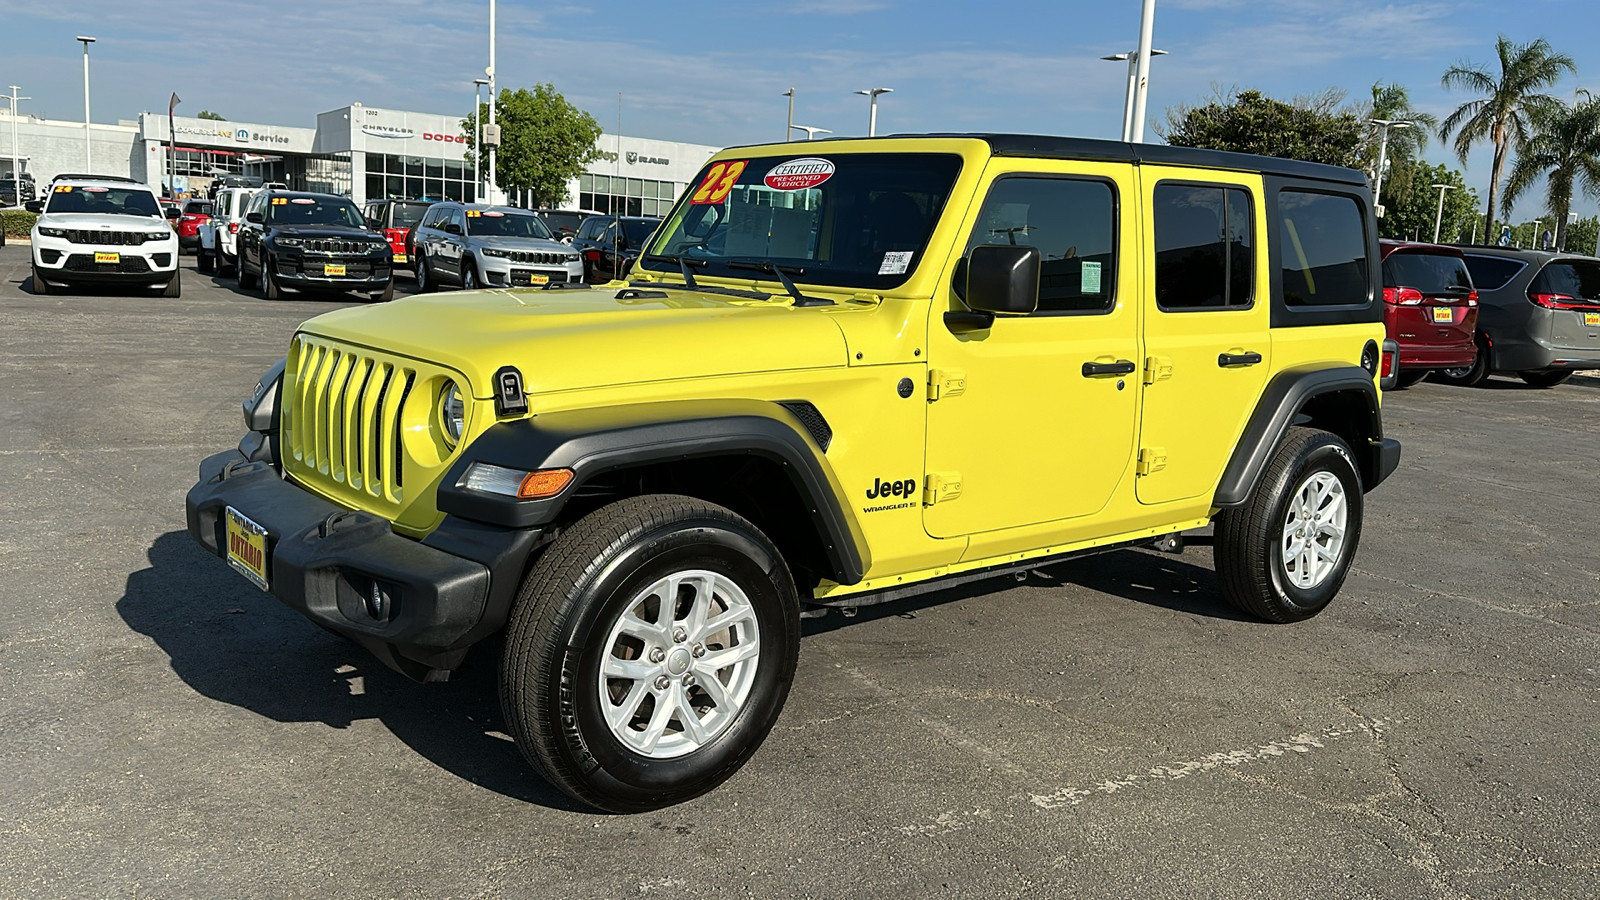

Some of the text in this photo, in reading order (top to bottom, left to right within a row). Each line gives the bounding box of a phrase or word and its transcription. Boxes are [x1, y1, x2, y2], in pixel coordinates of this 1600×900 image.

[362, 124, 414, 134] CHRYSLER
[252, 133, 289, 143] Service
[638, 156, 669, 165] RAM
[775, 164, 829, 175] CERTIFIED
[693, 161, 745, 203] 23
[772, 174, 821, 183] PRE-OWNED
[866, 478, 916, 499] Jeep
[863, 502, 908, 513] WRANGLER
[230, 531, 262, 571] ONTARIO
